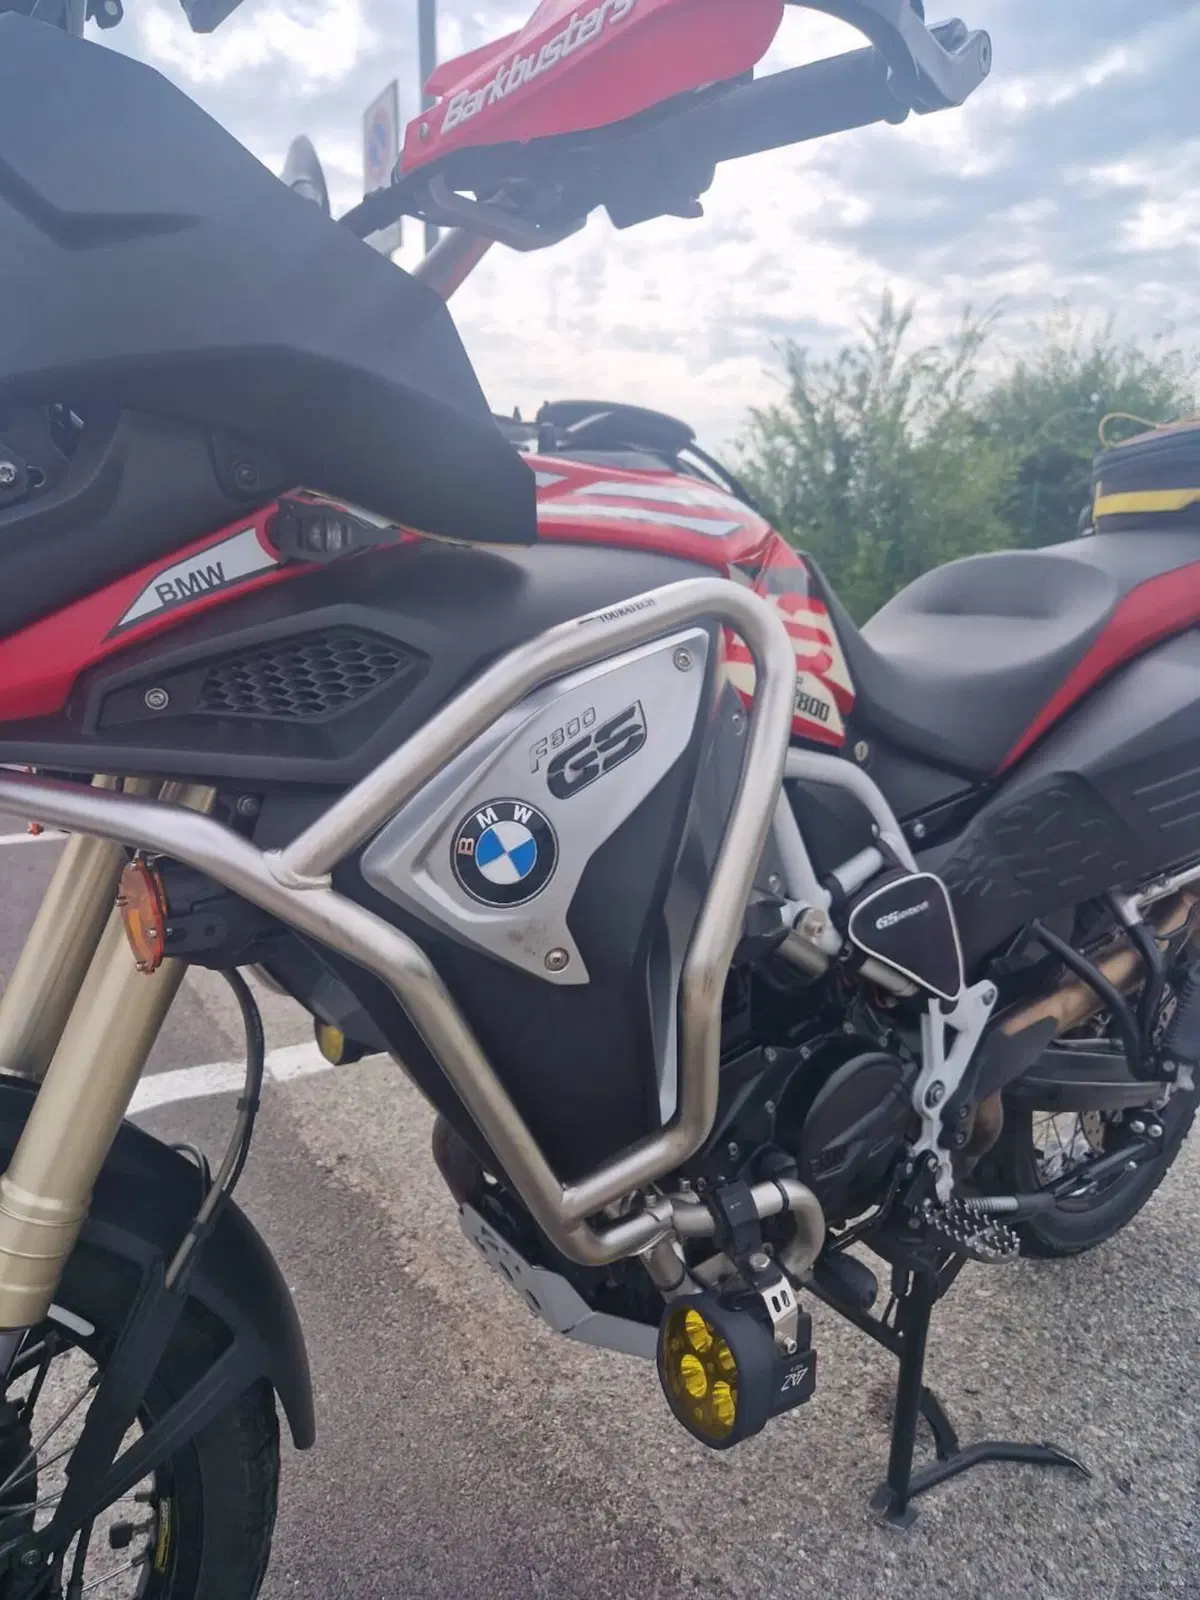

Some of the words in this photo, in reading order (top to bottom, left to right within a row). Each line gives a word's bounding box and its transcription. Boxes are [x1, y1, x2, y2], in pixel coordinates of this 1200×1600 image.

[154, 561, 226, 605] BMW
[529, 706, 596, 774] F800
[546, 699, 648, 800] GS
[457, 805, 533, 856] BMW
